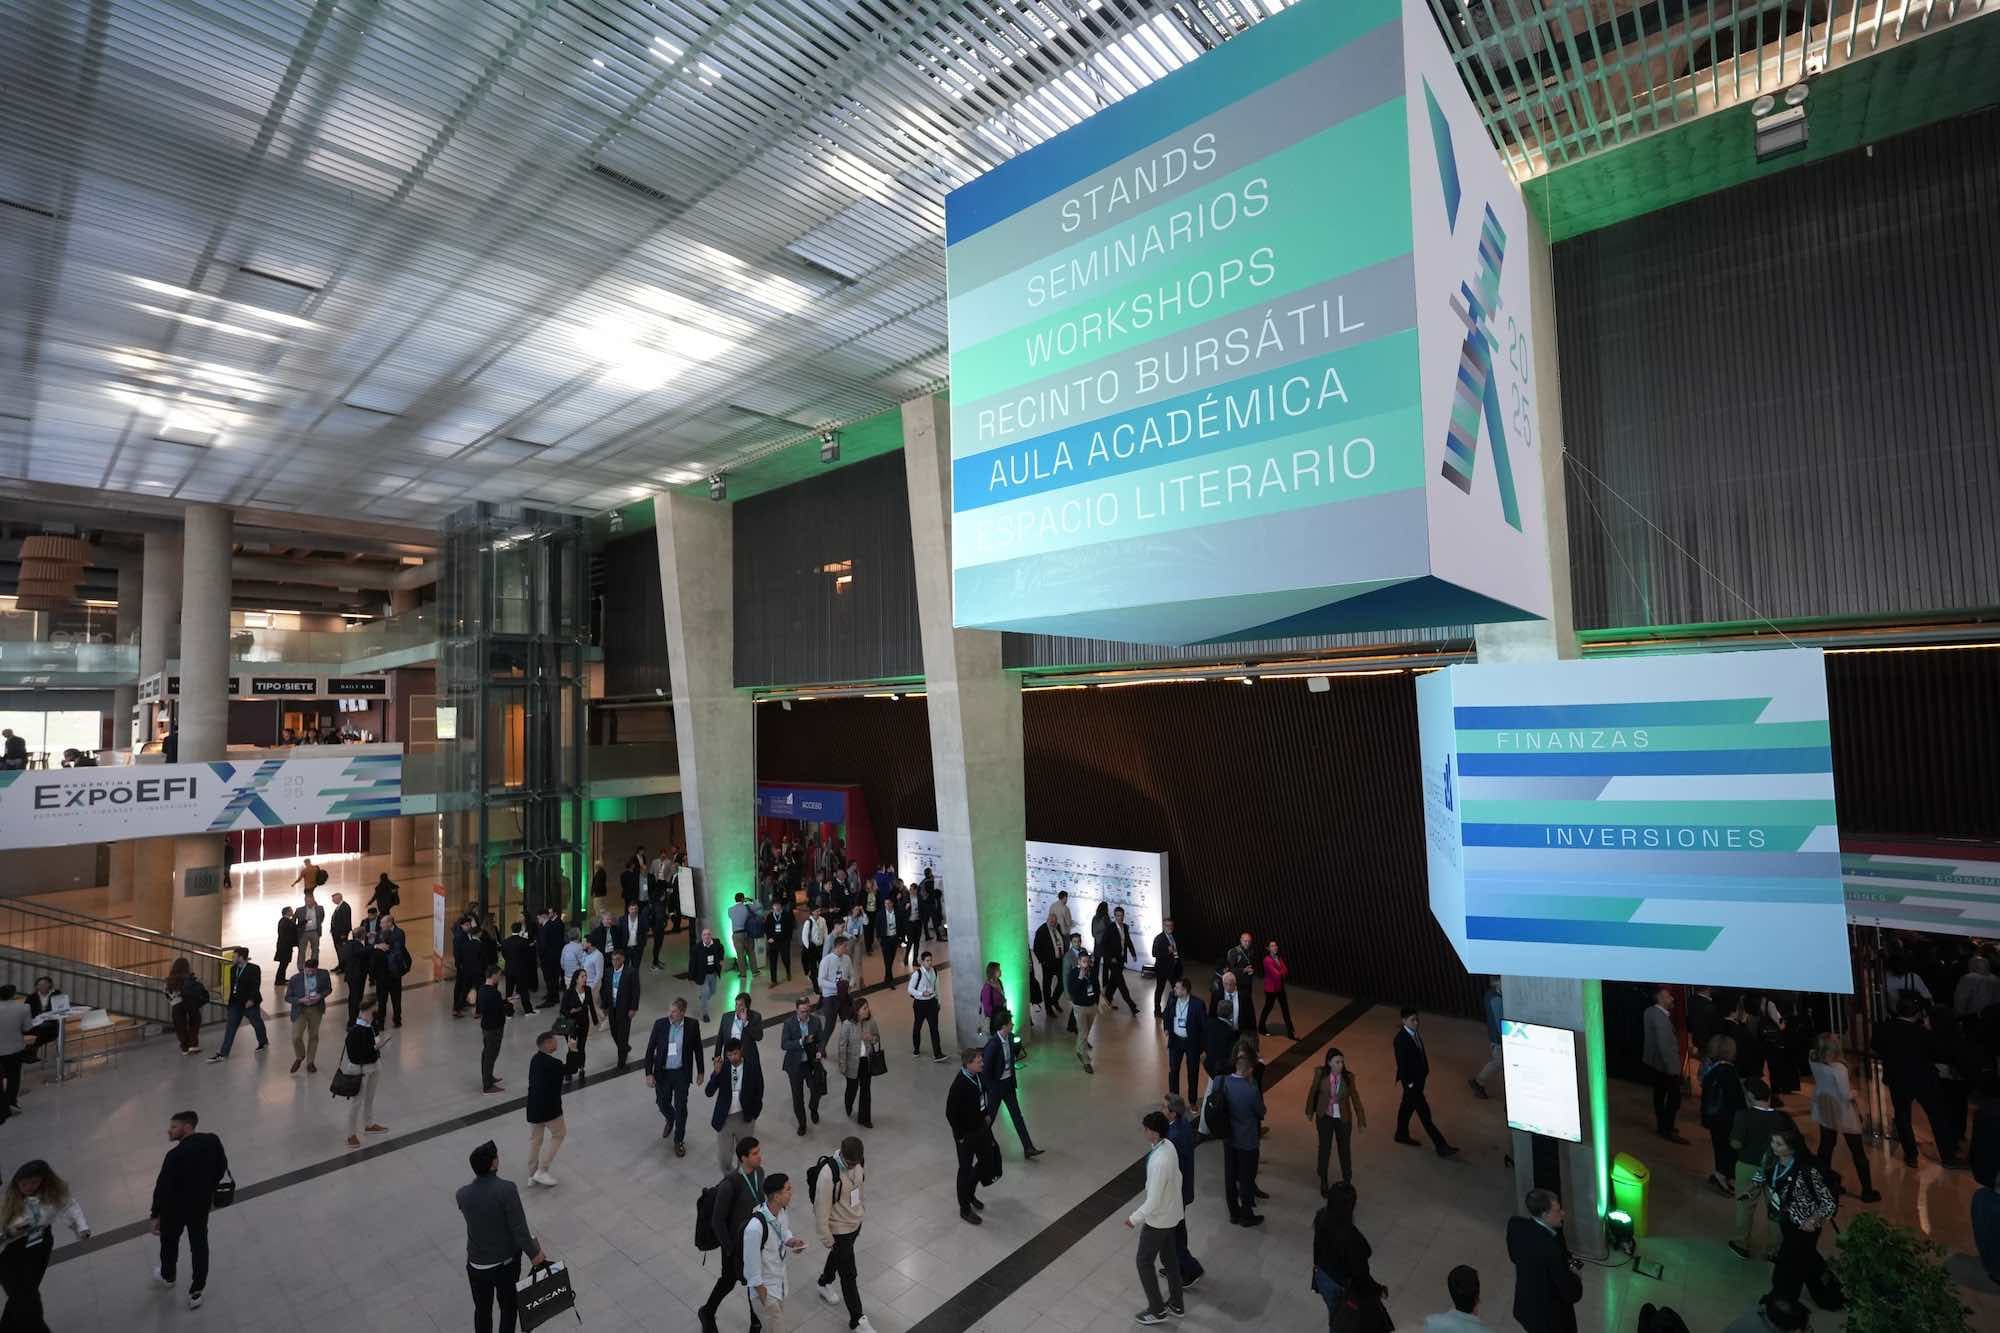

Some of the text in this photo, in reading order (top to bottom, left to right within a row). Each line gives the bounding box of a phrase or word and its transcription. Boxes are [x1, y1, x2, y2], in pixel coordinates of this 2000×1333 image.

[1061, 132, 1218, 233] STANDS
[1027, 178, 1270, 308] SEMINARIOS
[1025, 247, 1276, 368] WORKSHOPS
[1508, 316, 1529, 385] 20
[978, 295, 1366, 442] RECINTO BURSÁTIL
[988, 366, 1349, 492] AULA ACADÉMICA
[1511, 382, 1533, 448] 25
[1135, 436, 1377, 520] LITERARIO
[1496, 730, 1649, 749] FINANZAS
[1546, 828, 1766, 848] INVERSIONES
